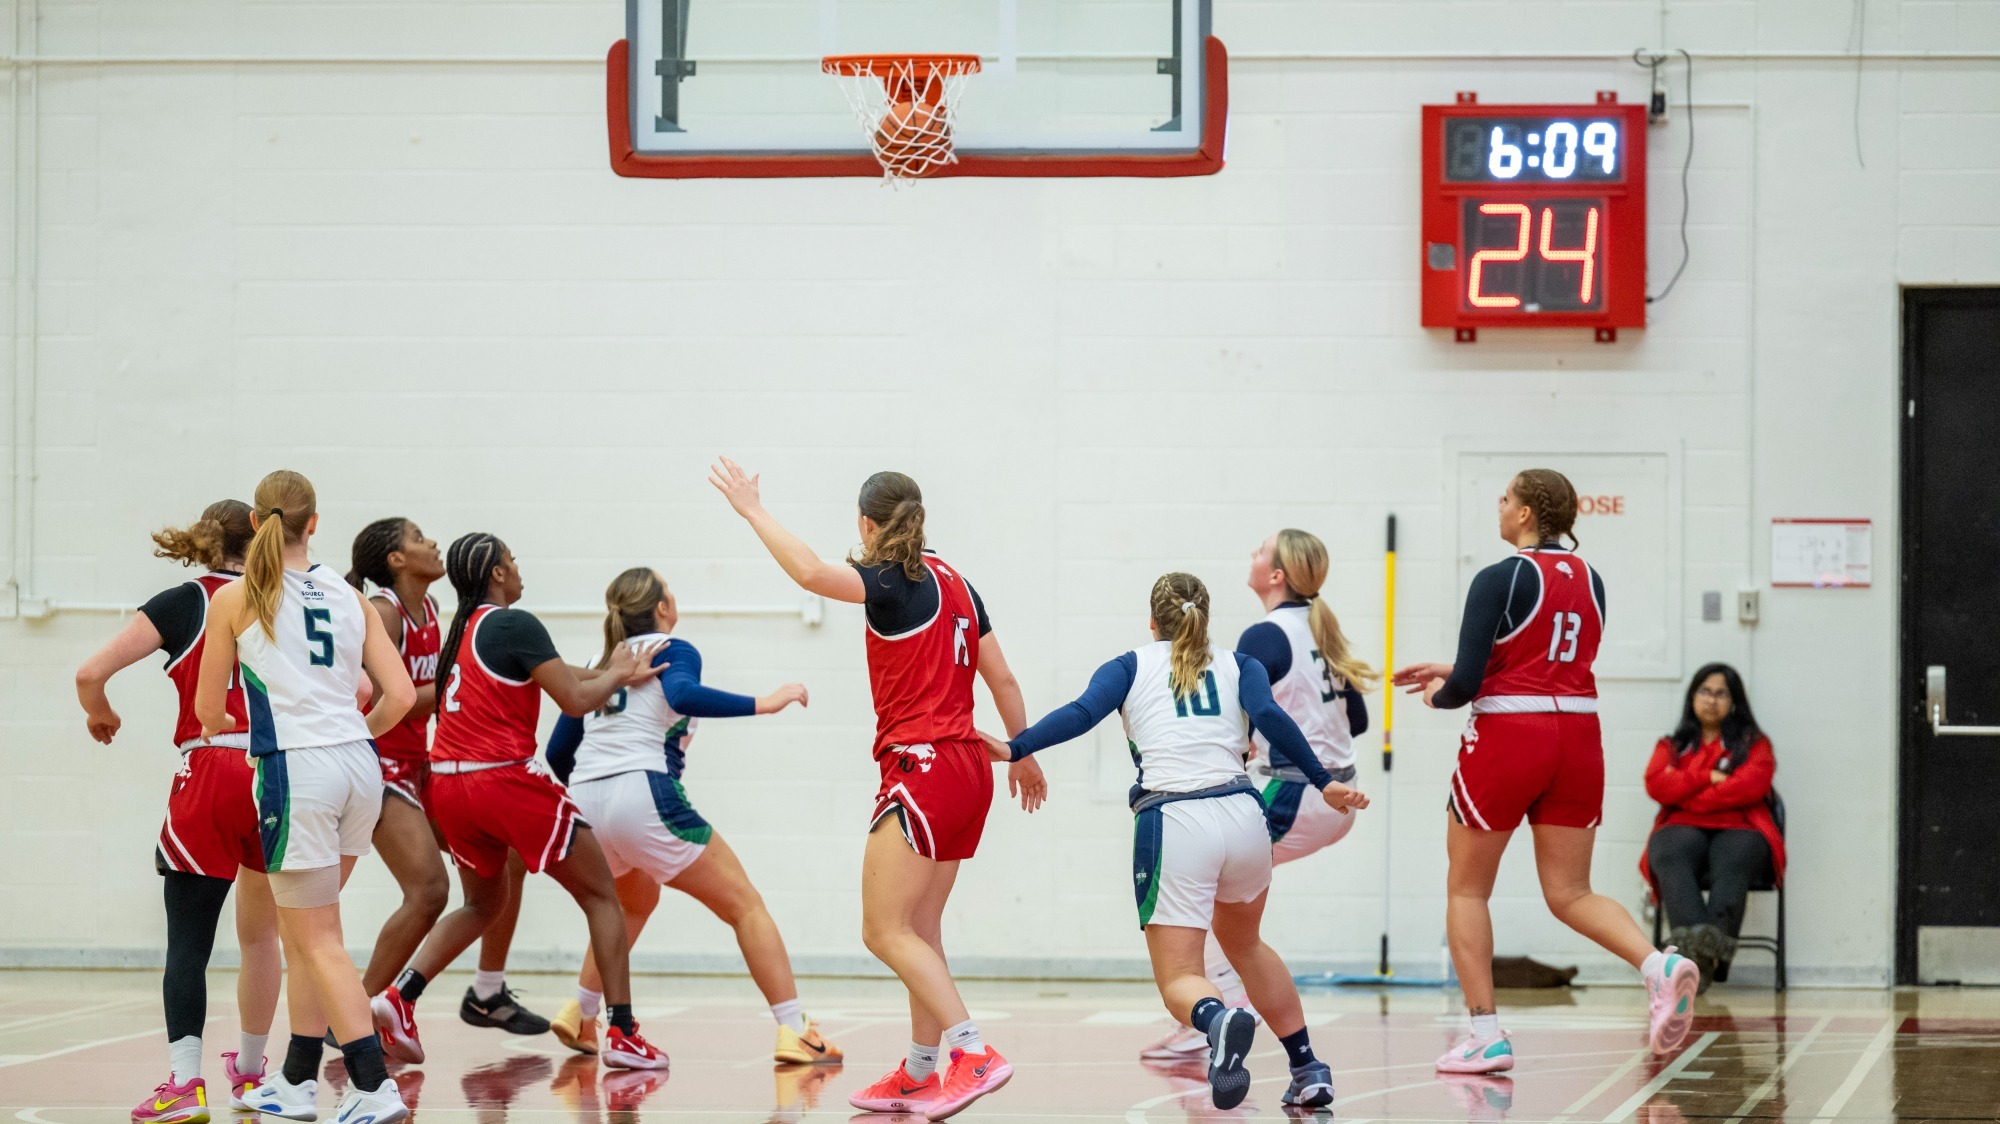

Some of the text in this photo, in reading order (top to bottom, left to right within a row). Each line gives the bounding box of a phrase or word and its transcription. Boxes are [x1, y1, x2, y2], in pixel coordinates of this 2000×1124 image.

[1489, 121, 1617, 178] 6:09
[1468, 203, 1598, 308] 24
[1577, 496, 1624, 514] OSE
[303, 605, 334, 669] 5
[1547, 611, 1582, 663] 13
[1168, 669, 1222, 718] 10
[1310, 650, 1347, 703] 3
